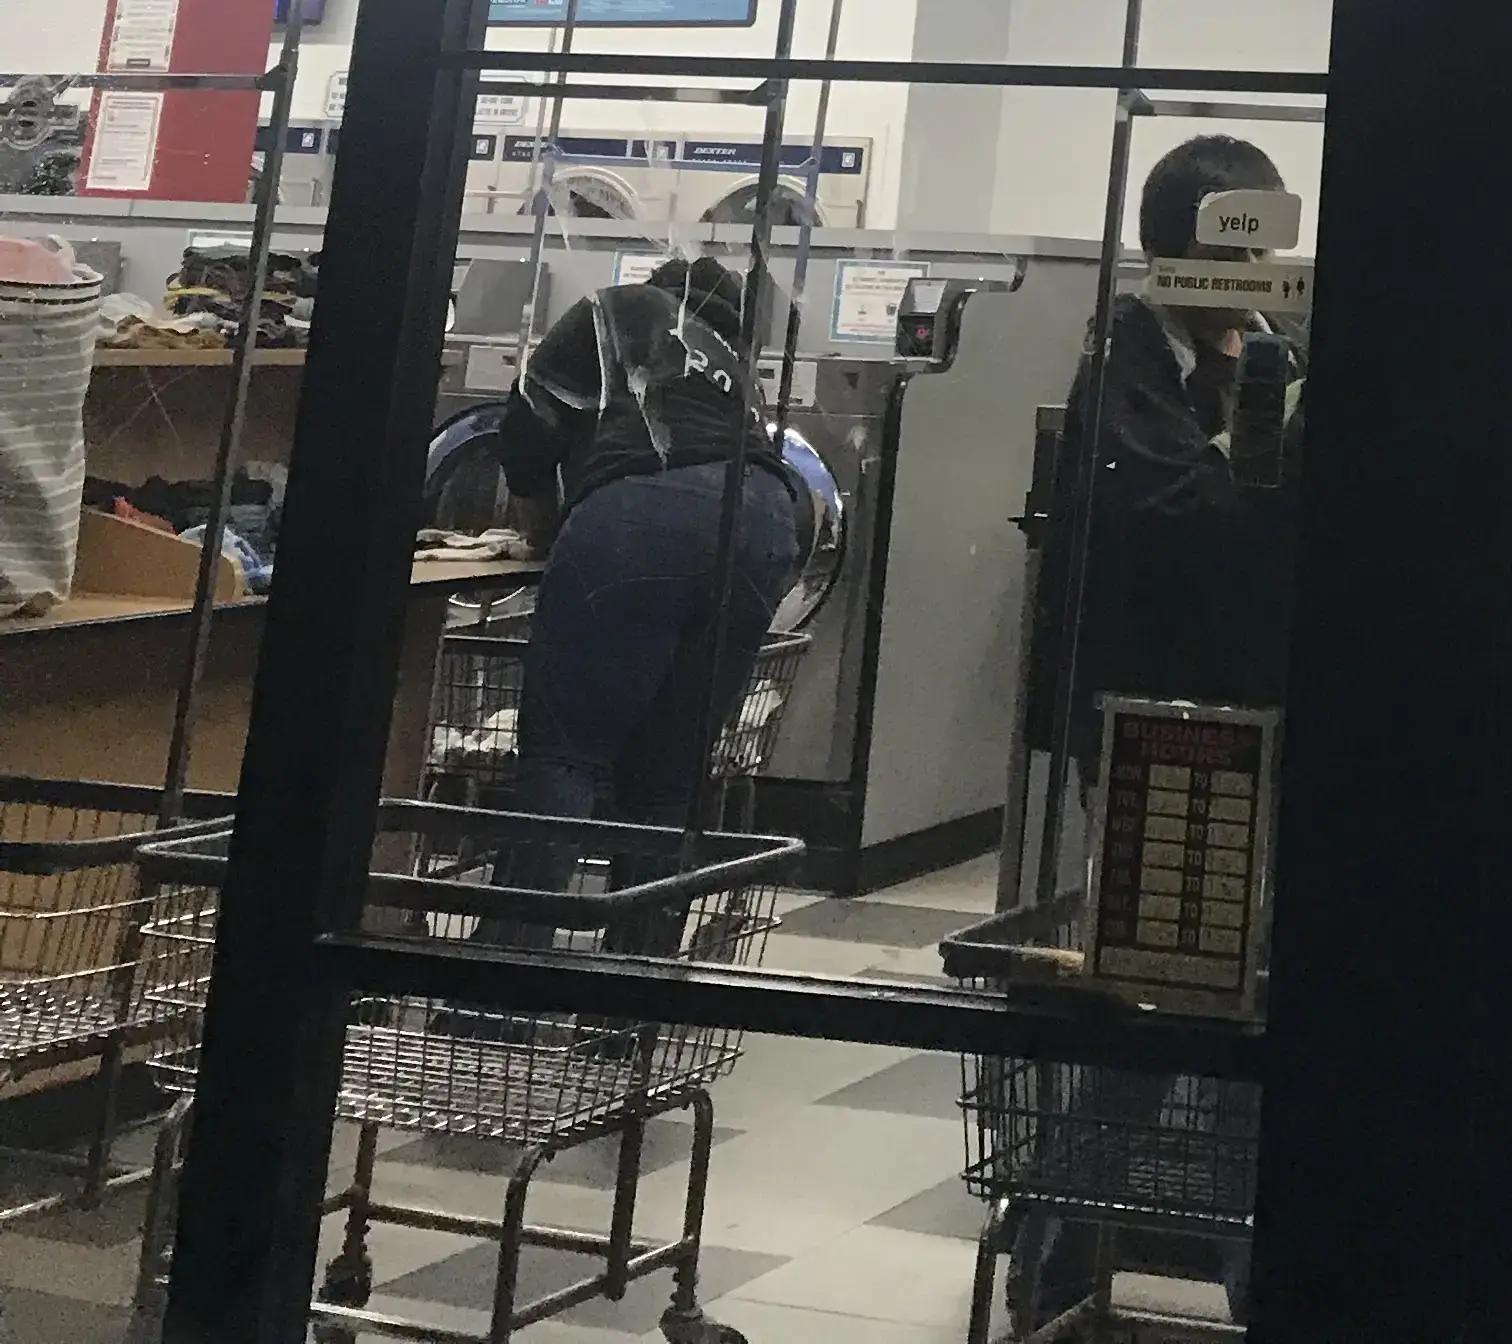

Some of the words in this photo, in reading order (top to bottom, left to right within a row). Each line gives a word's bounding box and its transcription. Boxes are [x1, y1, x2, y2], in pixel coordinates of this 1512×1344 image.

[693, 146, 737, 156] DEXTER
[1218, 211, 1260, 235] yelp
[1156, 274, 1172, 289] NO
[1174, 275, 1210, 291] PUBLIC
[1211, 277, 1273, 294] RESTROOMS
[1123, 720, 1256, 749] BUSINES
[1187, 850, 1202, 866] TO
